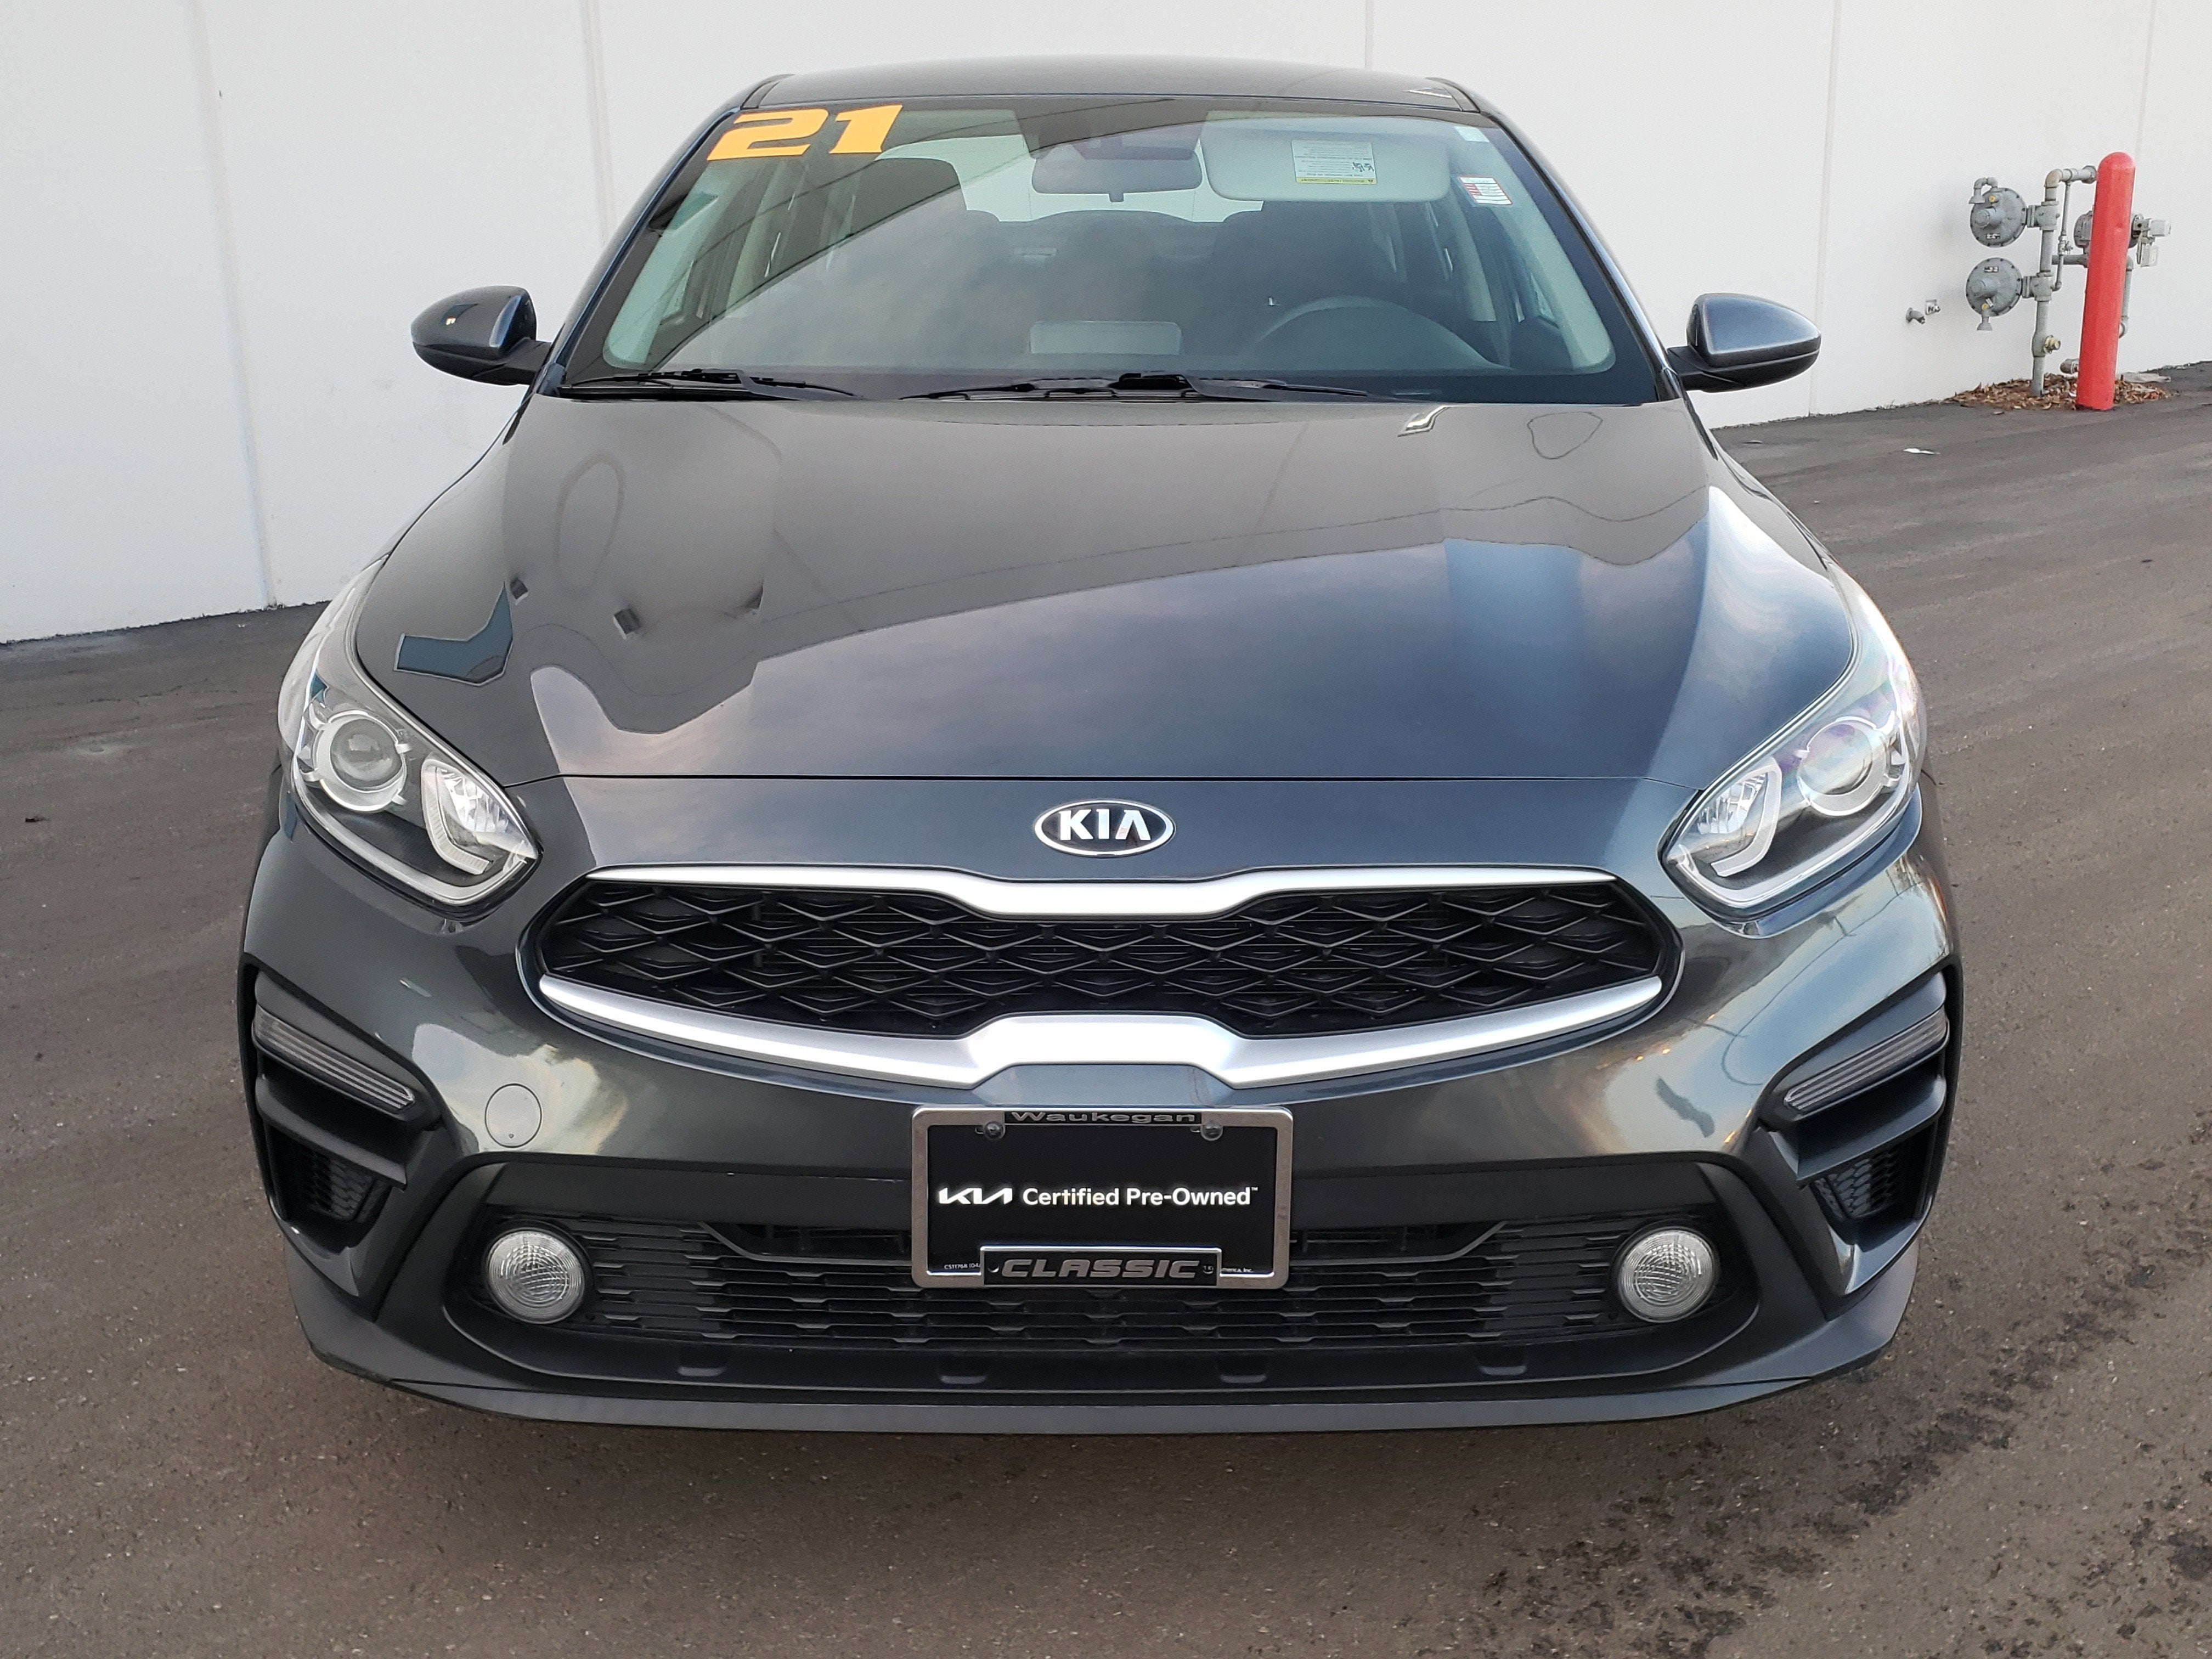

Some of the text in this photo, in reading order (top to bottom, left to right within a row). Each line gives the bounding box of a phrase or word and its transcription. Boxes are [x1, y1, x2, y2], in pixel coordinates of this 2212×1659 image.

[707, 104, 902, 161] 21
[1059, 809, 1151, 840] KIA
[1011, 1111, 1195, 1124] Waukegan
[939, 1188, 1013, 1205] KIA
[1023, 1187, 1120, 1206] Certified
[1001, 1259, 1200, 1279] CLASSIC
